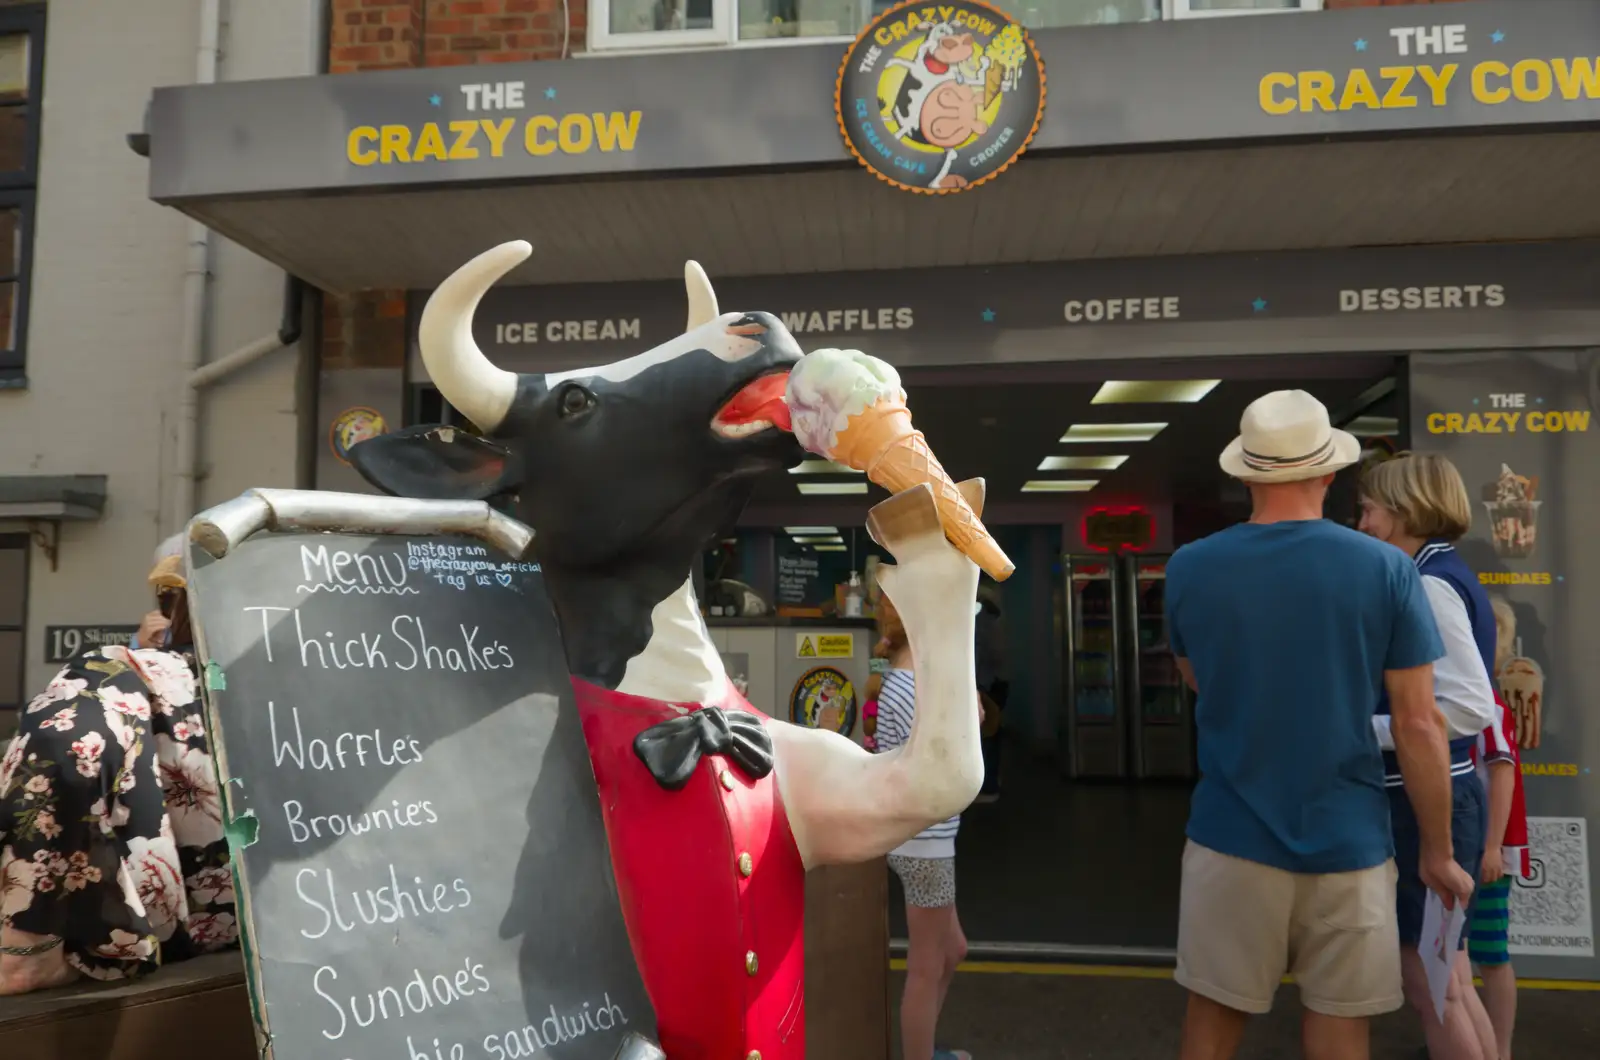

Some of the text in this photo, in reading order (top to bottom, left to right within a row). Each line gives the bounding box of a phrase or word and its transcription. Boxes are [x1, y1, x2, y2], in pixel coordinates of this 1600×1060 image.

[859, 6, 996, 73] THE CRAZY COW
[1390, 24, 1467, 56] THE
[460, 81, 525, 111] THE
[1259, 56, 1600, 114] CRAZY COW
[855, 98, 868, 119] ICE
[347, 110, 642, 165] CRAZY COW
[861, 121, 892, 159] CREAM
[969, 126, 1014, 167] CROMER
[1063, 296, 1180, 322] COFFEE
[1339, 284, 1505, 312] DESSERTS
[496, 318, 640, 343] ICE CREAM
[781, 307, 914, 332] WAFFLES
[1489, 394, 1526, 408] THE
[1426, 411, 1590, 434] CRAZY COW
[300, 544, 407, 586] Menu
[407, 541, 487, 562] Instagram
[433, 572, 491, 590] tag us
[1478, 572, 1552, 584] SUNDAES
[52, 629, 82, 659] 19
[283, 799, 438, 843] Brownie's
[296, 864, 472, 939] Slushies
[313, 957, 490, 1040] Sundae's
[483, 992, 629, 1060] sandwich
